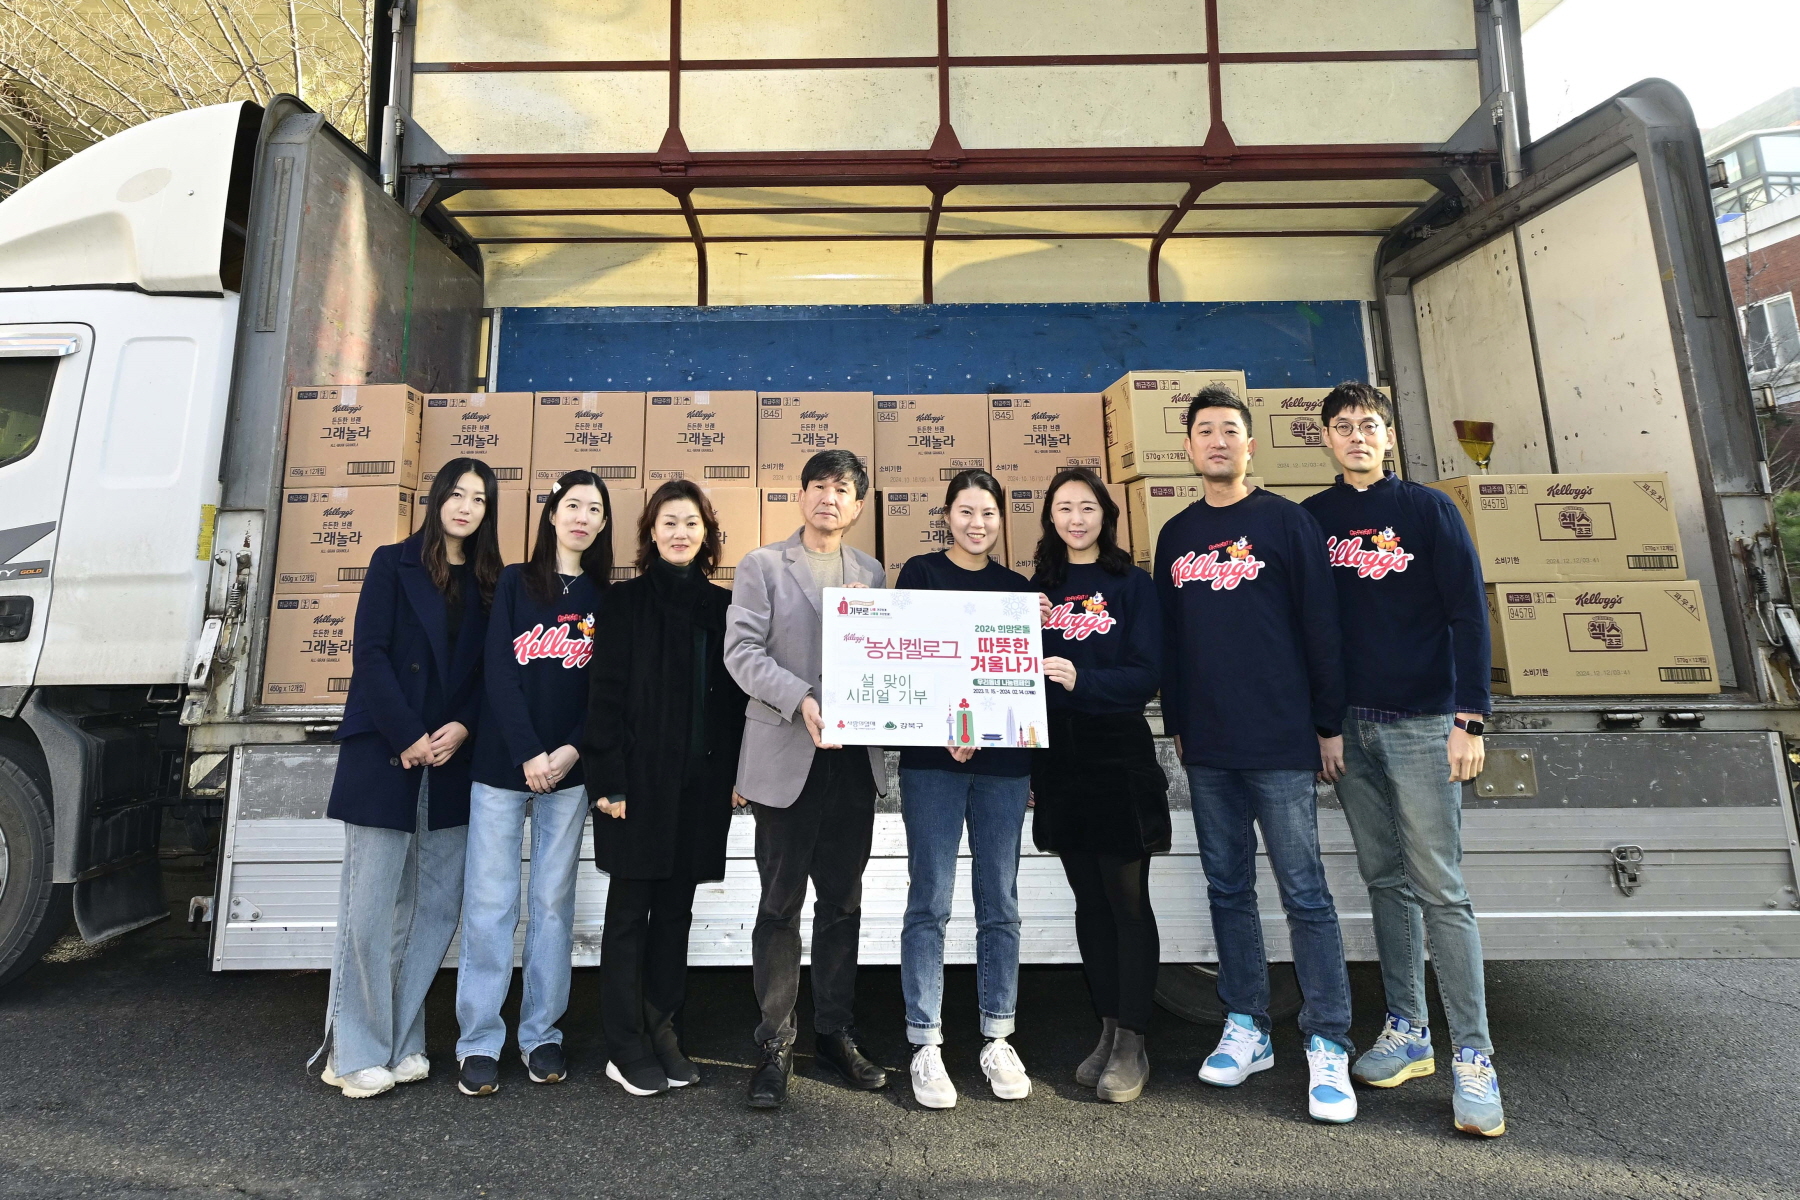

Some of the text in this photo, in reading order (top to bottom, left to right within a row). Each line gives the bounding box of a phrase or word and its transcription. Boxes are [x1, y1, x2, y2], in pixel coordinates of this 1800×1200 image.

[1171, 393, 1193, 403] Kello
[1281, 397, 1324, 411] Kellogg's
[332, 404, 363, 414] Kellogg's
[574, 410, 604, 420] Kellogg's
[686, 410, 716, 420] Kellogg's
[763, 410, 780, 418] 845
[800, 410, 829, 420] Kellogg's
[994, 411, 1011, 419] 845
[461, 412, 491, 422] Kellogg's
[880, 413, 896, 421] 845
[916, 413, 945, 423] Kellogg's
[1031, 412, 1061, 421] Kellogg's
[320, 426, 371, 441] 그래놀라
[1292, 422, 1320, 437] 첵스
[450, 434, 499, 448] 그래놀라
[564, 432, 613, 447] 그래놀라
[676, 432, 725, 447] 그래놀라
[791, 433, 839, 447] 그래놀라
[908, 435, 955, 449] 그래놀라
[1023, 434, 1071, 448] 그래놀라
[1547, 483, 1594, 499] Kellogg's
[1642, 483, 1665, 503] 파우치
[890, 506, 907, 515] 845
[1014, 504, 1032, 512] 845
[1482, 499, 1506, 508] 9457B
[323, 507, 355, 518] Kellogg's
[1560, 512, 1591, 528] 첵스
[310, 531, 362, 547] 그래놀라
[920, 530, 954, 545] 그래놀
[1327, 536, 1413, 580] ellogg's
[1495, 557, 1520, 565] 소비기한
[1171, 550, 1263, 590] Kellogg's
[1575, 592, 1624, 609] Kellogg's
[1674, 592, 1696, 613] 파우치
[849, 607, 869, 615] 기부로
[1509, 608, 1534, 619] 9457B
[313, 614, 346, 626] Kellogg's
[1042, 602, 1116, 640] llogg's
[974, 625, 996, 633] 2024
[1590, 622, 1621, 638] 첵스
[843, 632, 865, 643] Kellogg's
[300, 640, 353, 656] 그래놀라
[513, 623, 593, 668] Kellogg
[864, 637, 962, 660] 농심켈로그
[978, 637, 1030, 654] 따뜻한
[970, 655, 1039, 673] 겨울나기
[1523, 668, 1549, 677] 소비기한
[861, 673, 911, 689] 설 맞이
[847, 688, 928, 705] 시리얼 기부
